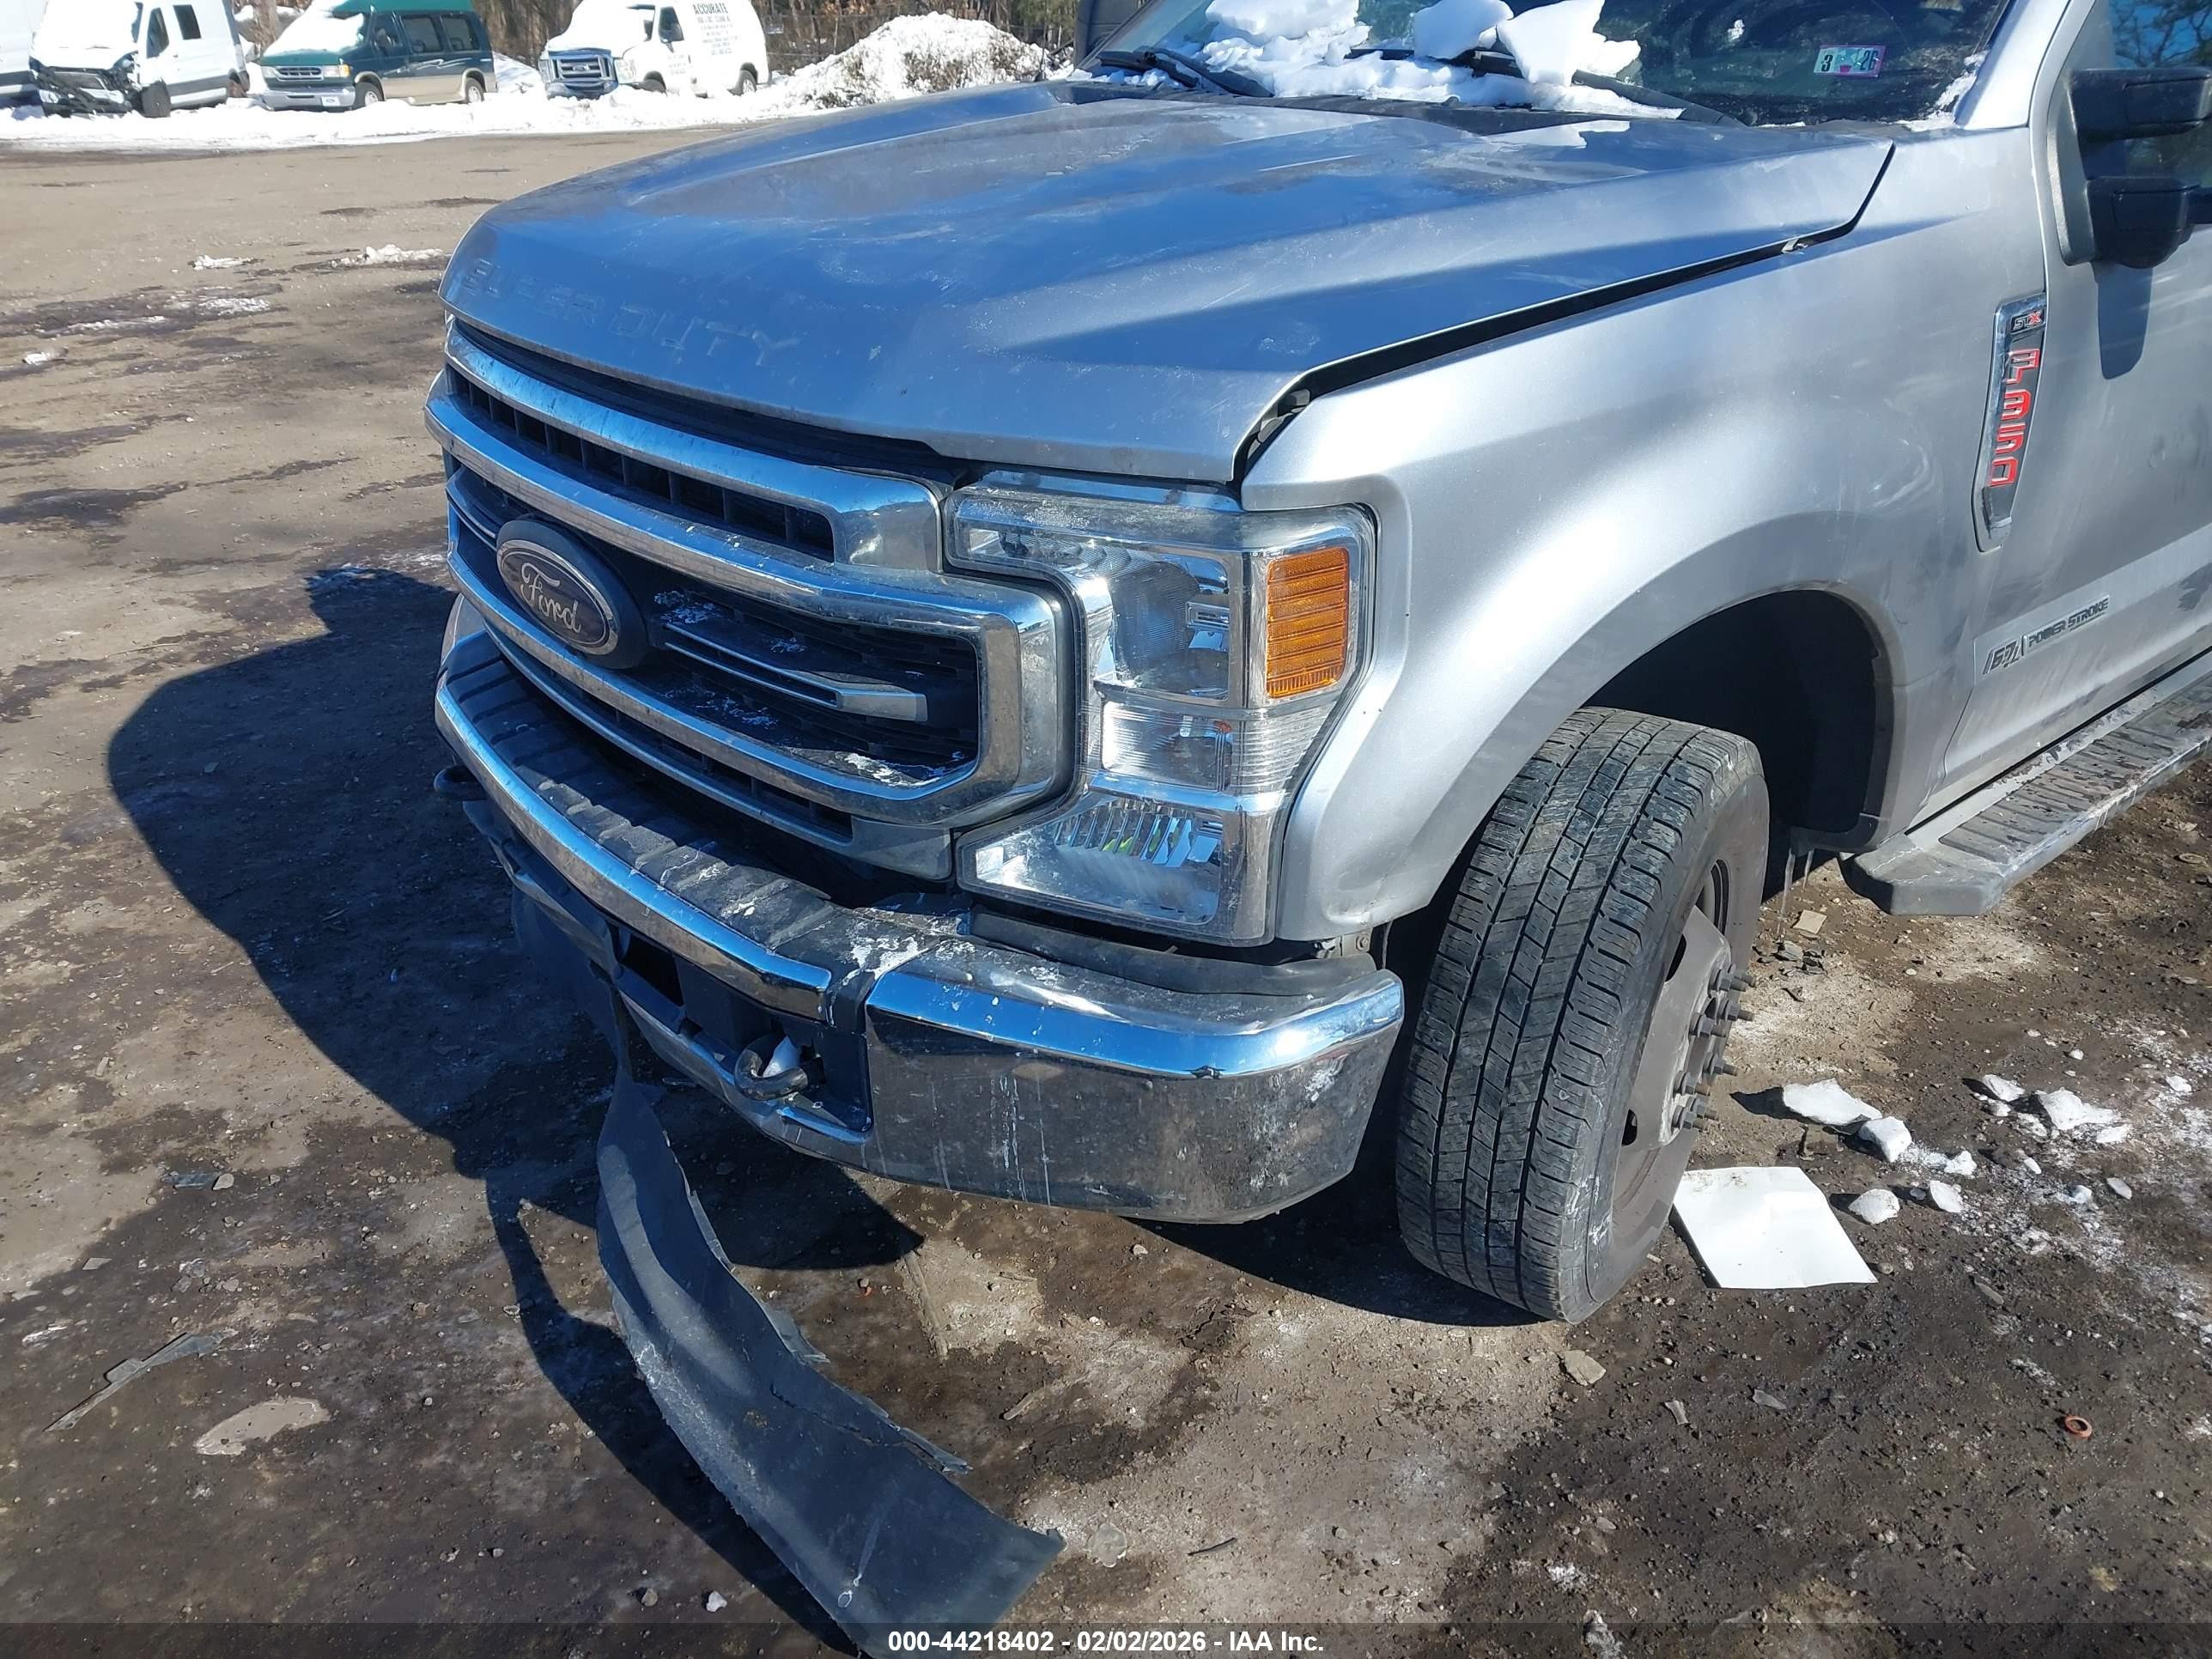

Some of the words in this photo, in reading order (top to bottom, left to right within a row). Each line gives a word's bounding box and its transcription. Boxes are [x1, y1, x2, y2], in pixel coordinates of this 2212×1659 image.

[692, 3, 729, 15] ACCURATE
[1820, 54, 1834, 72] 3
[1859, 50, 1879, 71] 26
[520, 562, 581, 634] Ford
[2028, 619, 2067, 647] POWER
[2067, 598, 2110, 629] STROKE
